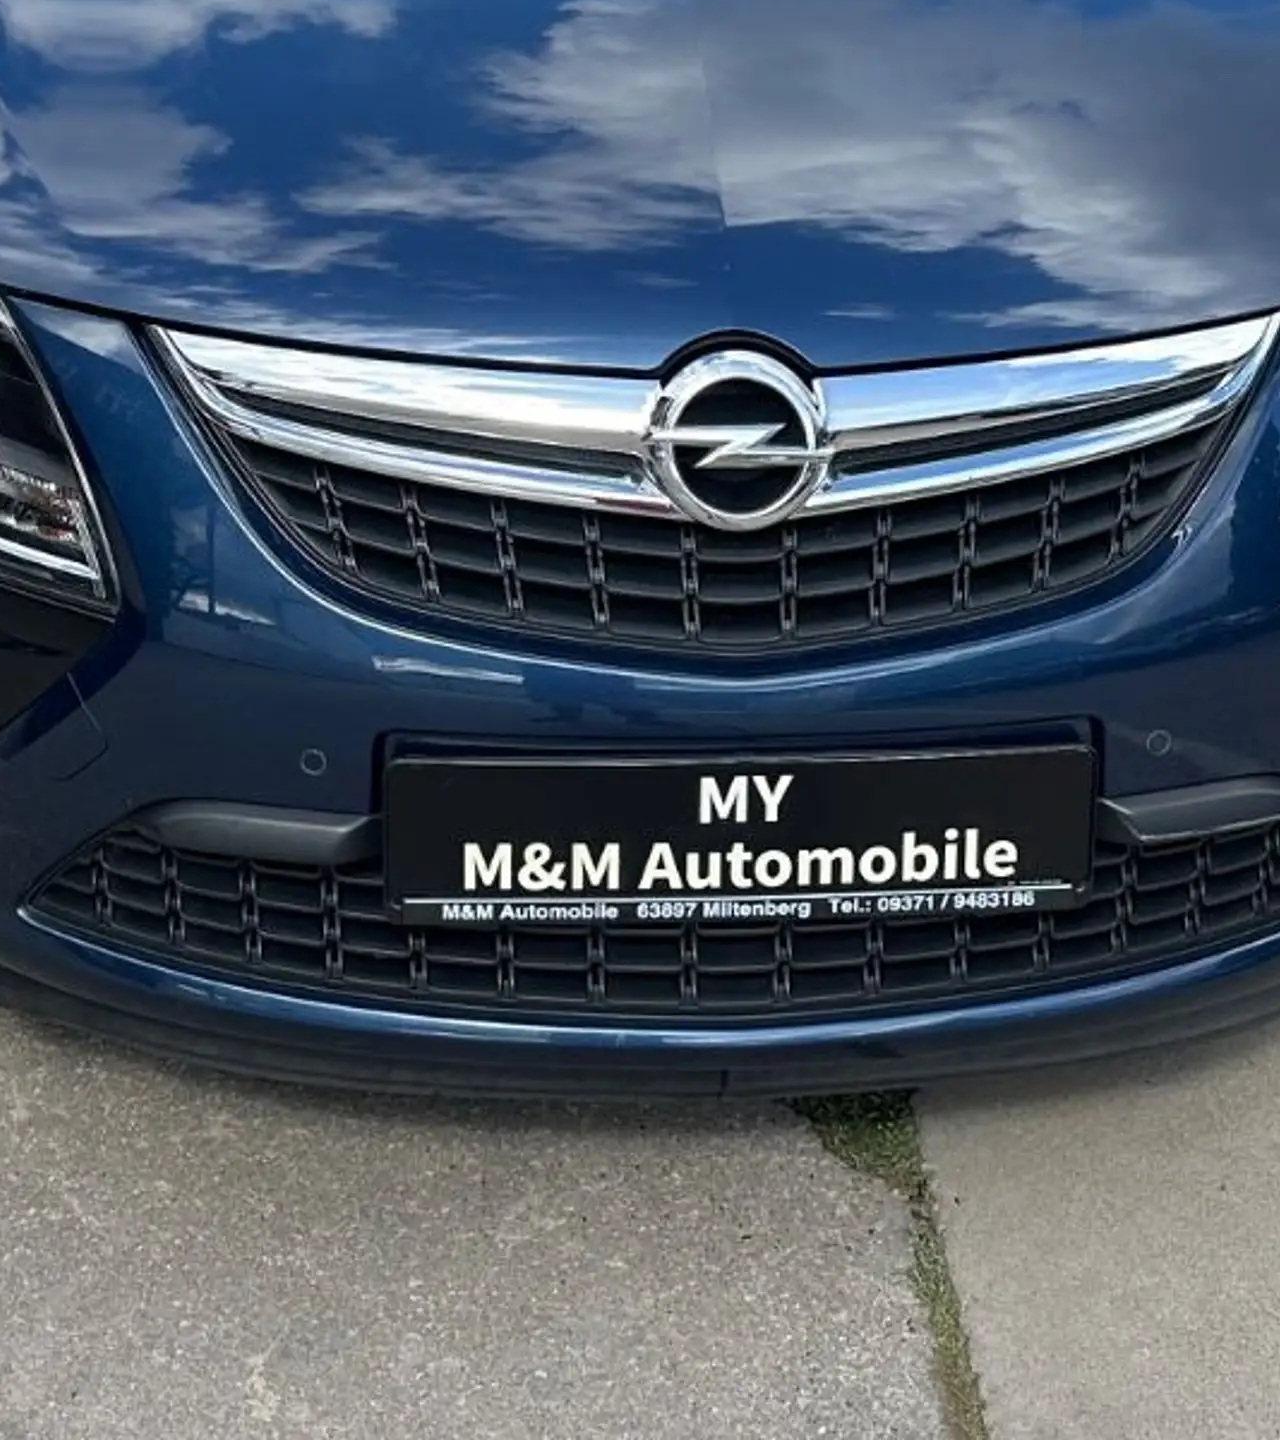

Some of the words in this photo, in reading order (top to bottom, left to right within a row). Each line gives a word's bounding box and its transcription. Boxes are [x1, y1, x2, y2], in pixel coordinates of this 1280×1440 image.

[699, 775, 794, 824] MY
[463, 842, 620, 890] M&M
[637, 828, 1019, 890] Automobile
[441, 903, 494, 921] M&M
[499, 901, 619, 921] Automobile
[637, 901, 696, 919] 63897
[702, 898, 811, 919] Miltenberg
[828, 897, 872, 914] Tel.:
[877, 895, 935, 912] 09371
